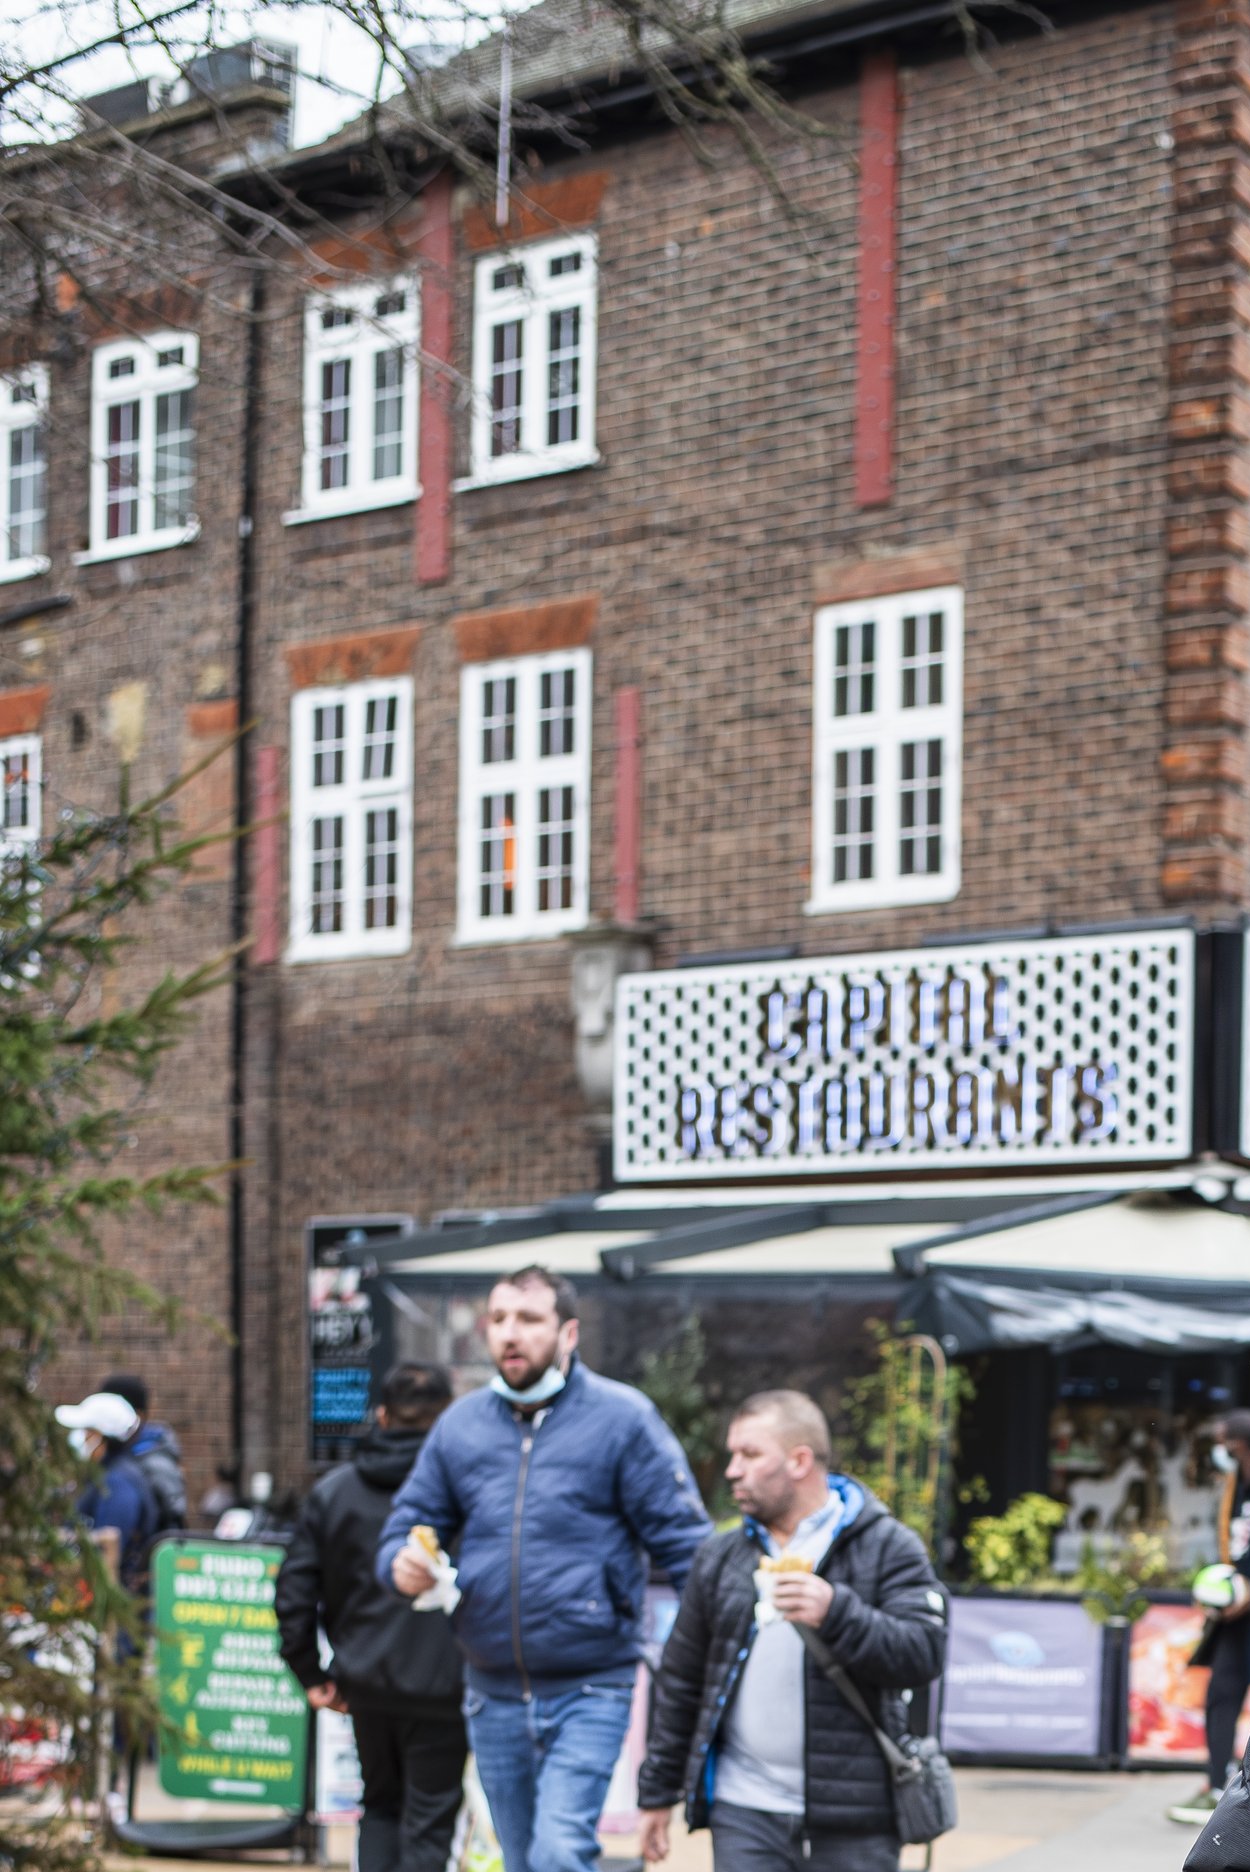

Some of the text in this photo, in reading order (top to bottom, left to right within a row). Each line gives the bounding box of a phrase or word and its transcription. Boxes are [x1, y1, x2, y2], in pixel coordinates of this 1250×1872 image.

[766, 974, 1022, 1061] CAPITAL
[681, 1060, 1118, 1156] RESTAURANTS
[221, 1578, 277, 1604] CLEA
